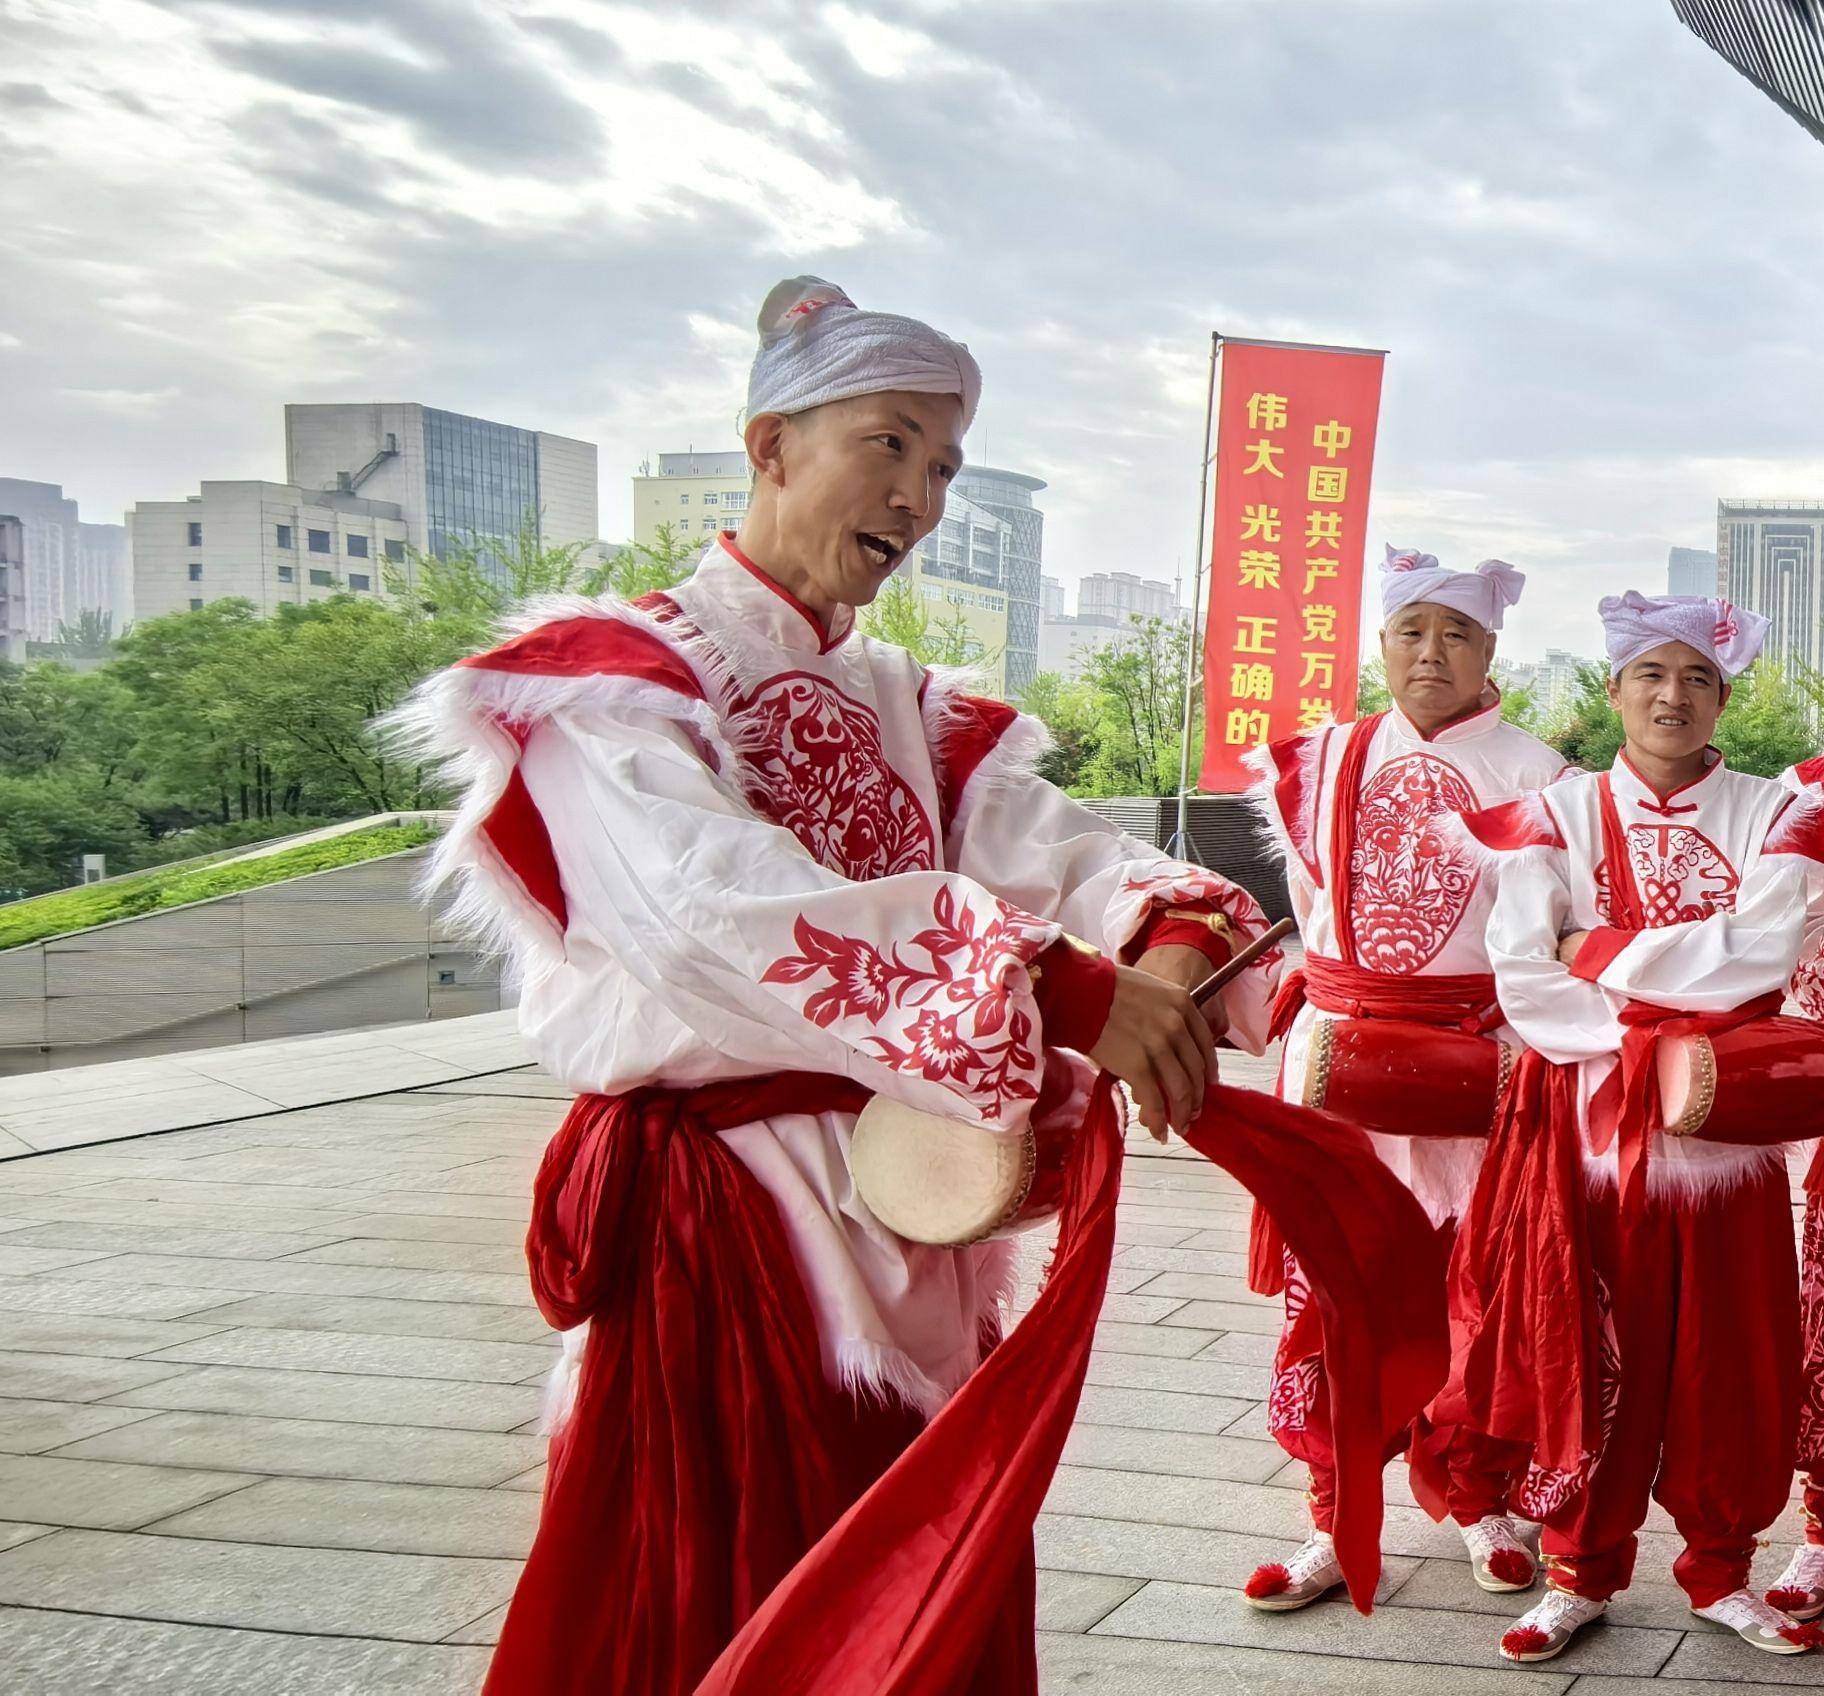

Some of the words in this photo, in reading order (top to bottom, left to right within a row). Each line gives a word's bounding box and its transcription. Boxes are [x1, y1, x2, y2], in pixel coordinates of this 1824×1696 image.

[1296, 420, 1351, 736] 中国共产党万岁
